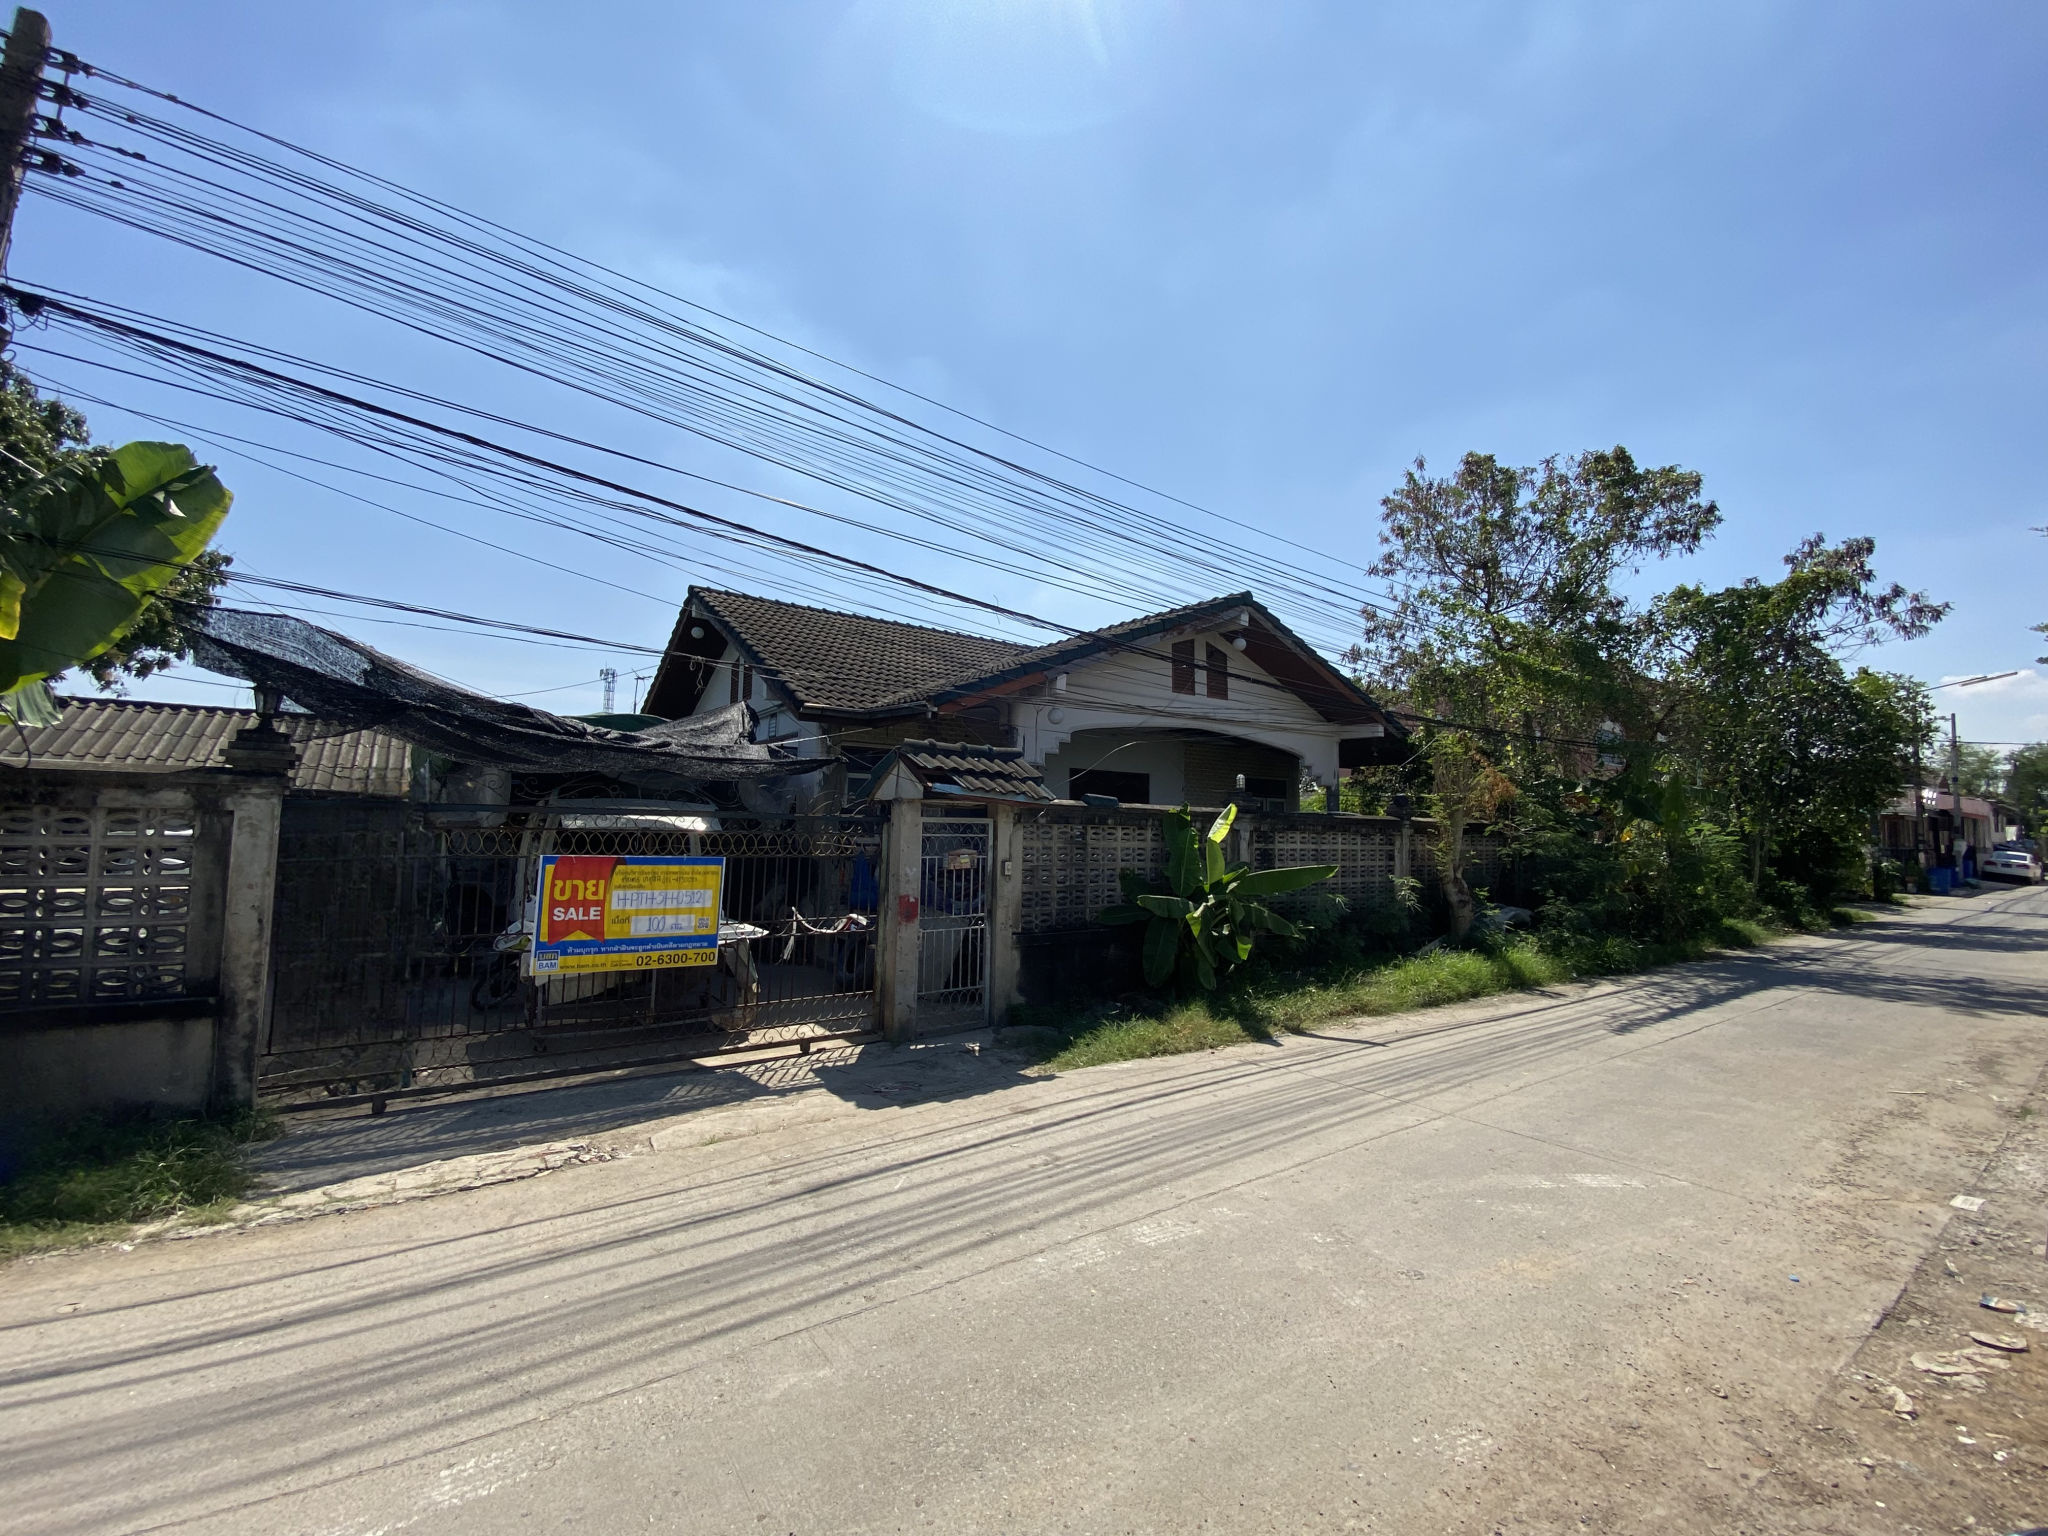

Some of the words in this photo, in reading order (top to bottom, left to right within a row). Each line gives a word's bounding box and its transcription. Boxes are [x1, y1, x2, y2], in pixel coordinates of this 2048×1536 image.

[553, 879, 605, 901] ขาย
[552, 906, 602, 922] SALE
[646, 916, 666, 932] 100
[538, 961, 557, 969] BAM
[636, 951, 716, 967] 02-6300-700
